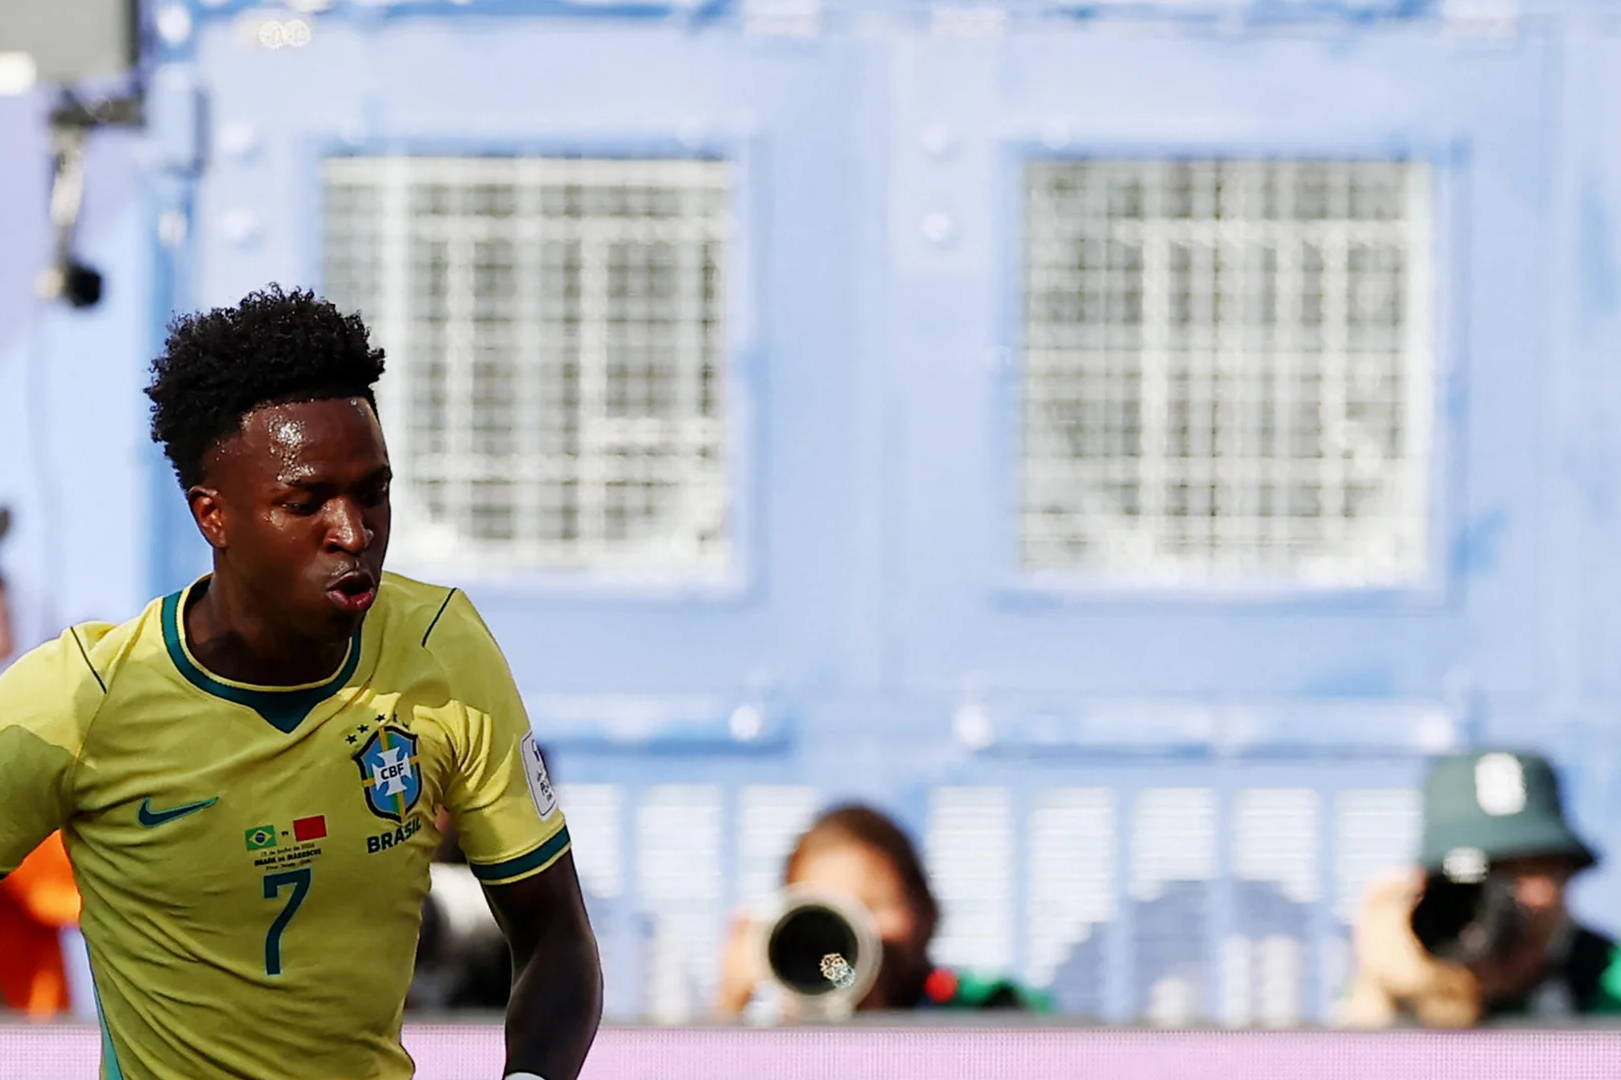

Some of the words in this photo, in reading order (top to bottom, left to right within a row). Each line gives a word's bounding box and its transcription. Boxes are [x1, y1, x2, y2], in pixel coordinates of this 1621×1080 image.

[380, 762, 405, 780] CBF
[366, 817, 421, 854] BRASIL
[262, 867, 312, 977] 7
